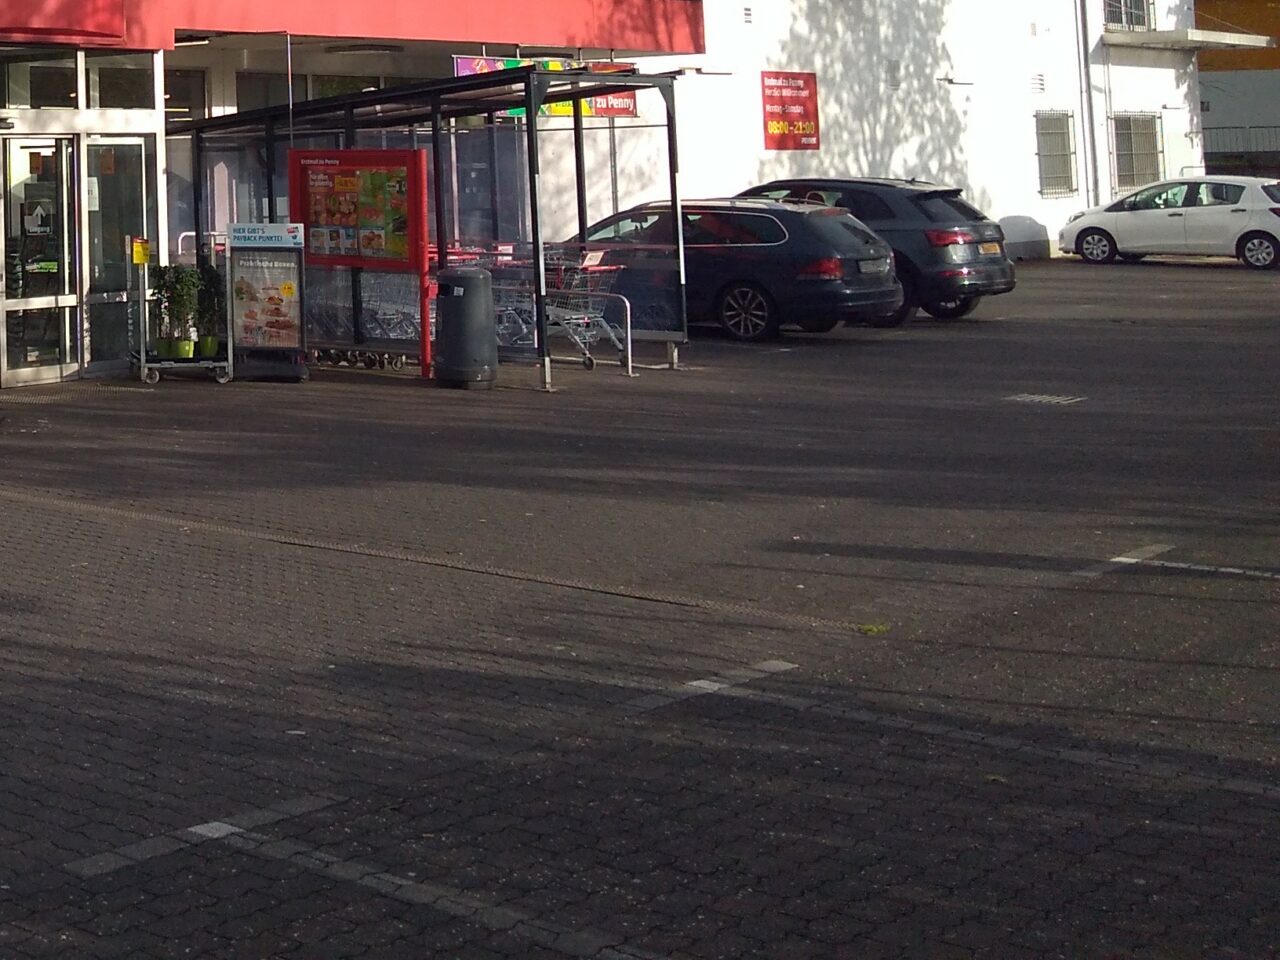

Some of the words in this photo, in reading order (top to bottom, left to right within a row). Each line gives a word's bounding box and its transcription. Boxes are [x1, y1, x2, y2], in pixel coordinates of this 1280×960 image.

[596, 98, 607, 108] zu
[608, 96, 634, 110] Penny
[793, 121, 815, 134] 21:00
